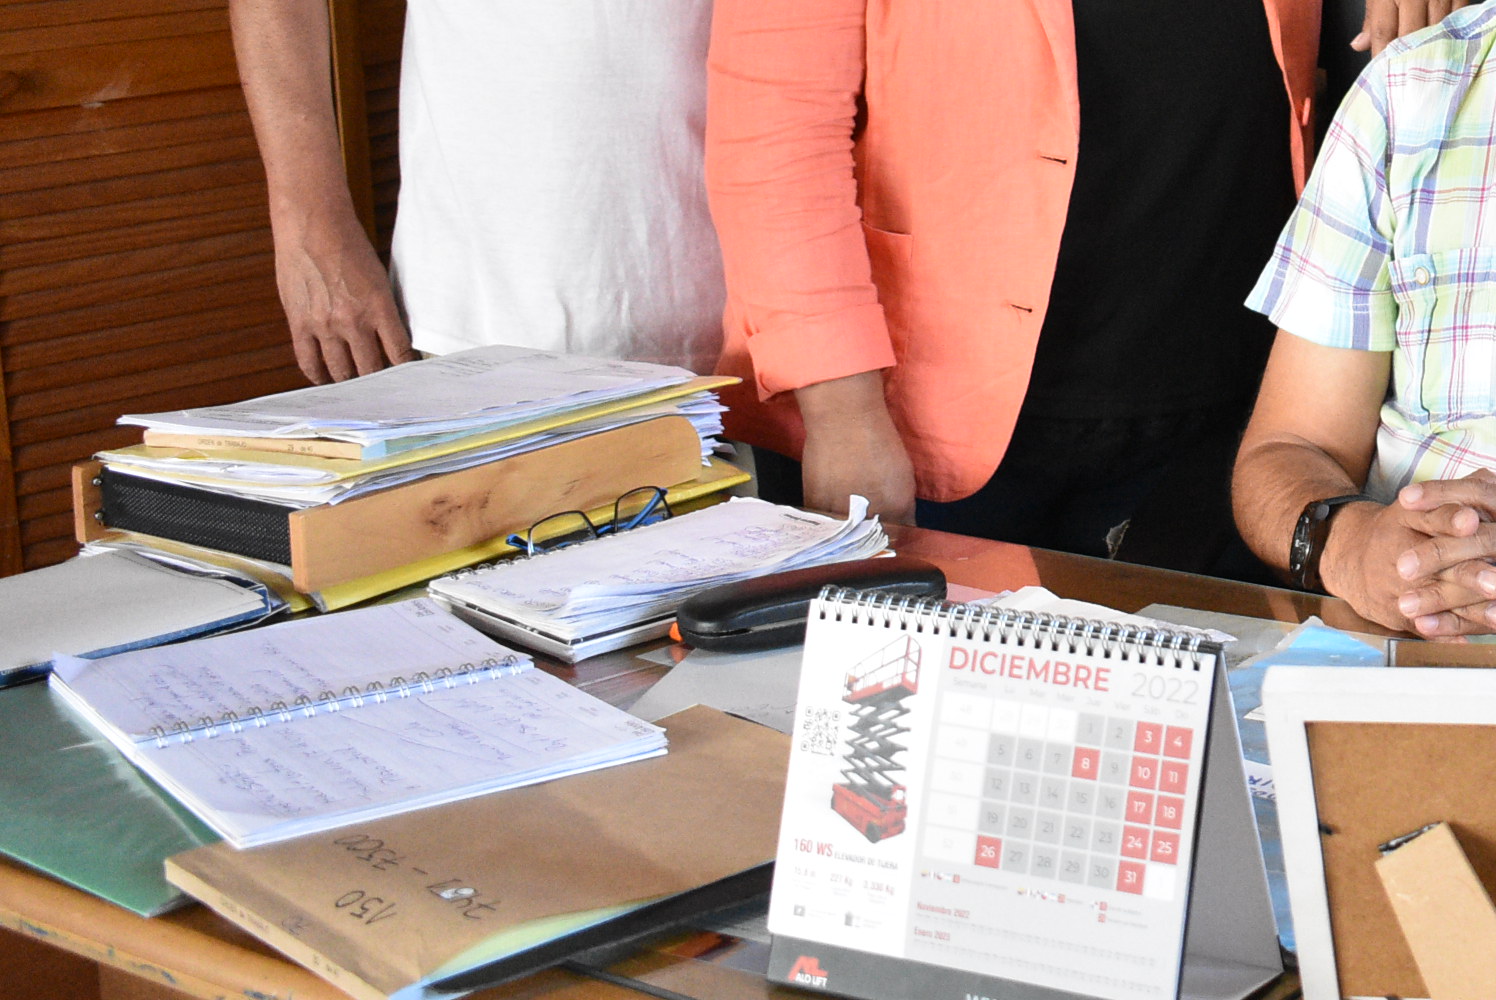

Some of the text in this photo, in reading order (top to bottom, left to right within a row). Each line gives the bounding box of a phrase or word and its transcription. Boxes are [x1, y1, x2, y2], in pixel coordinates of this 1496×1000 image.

[948, 646, 1199, 705] DICIEMBRE 2022
[1115, 727, 1123, 738] 2
[1144, 731, 1152, 742] 3
[1173, 736, 1182, 747] 4
[997, 744, 1005, 755] 5
[1081, 758, 1090, 770] 8
[1138, 766, 1151, 779] 10
[1169, 771, 1179, 783] 11
[991, 778, 1002, 790] 12
[1020, 783, 1031, 795] 13
[1076, 791, 1088, 804] 15
[1133, 801, 1146, 814] 17
[1162, 805, 1176, 818] 18
[792, 838, 814, 853] 160
[816, 841, 834, 857] WS
[834, 851, 866, 864] ELEVADOR
[867, 857, 876, 866] DE
[1012, 817, 1028, 829] 20
[1042, 821, 1055, 834] 21
[1070, 827, 1084, 839] 22
[1127, 837, 1143, 849] 24
[1157, 841, 1172, 854] 25
[981, 846, 1136, 883] 26 27 28 29 30 31
